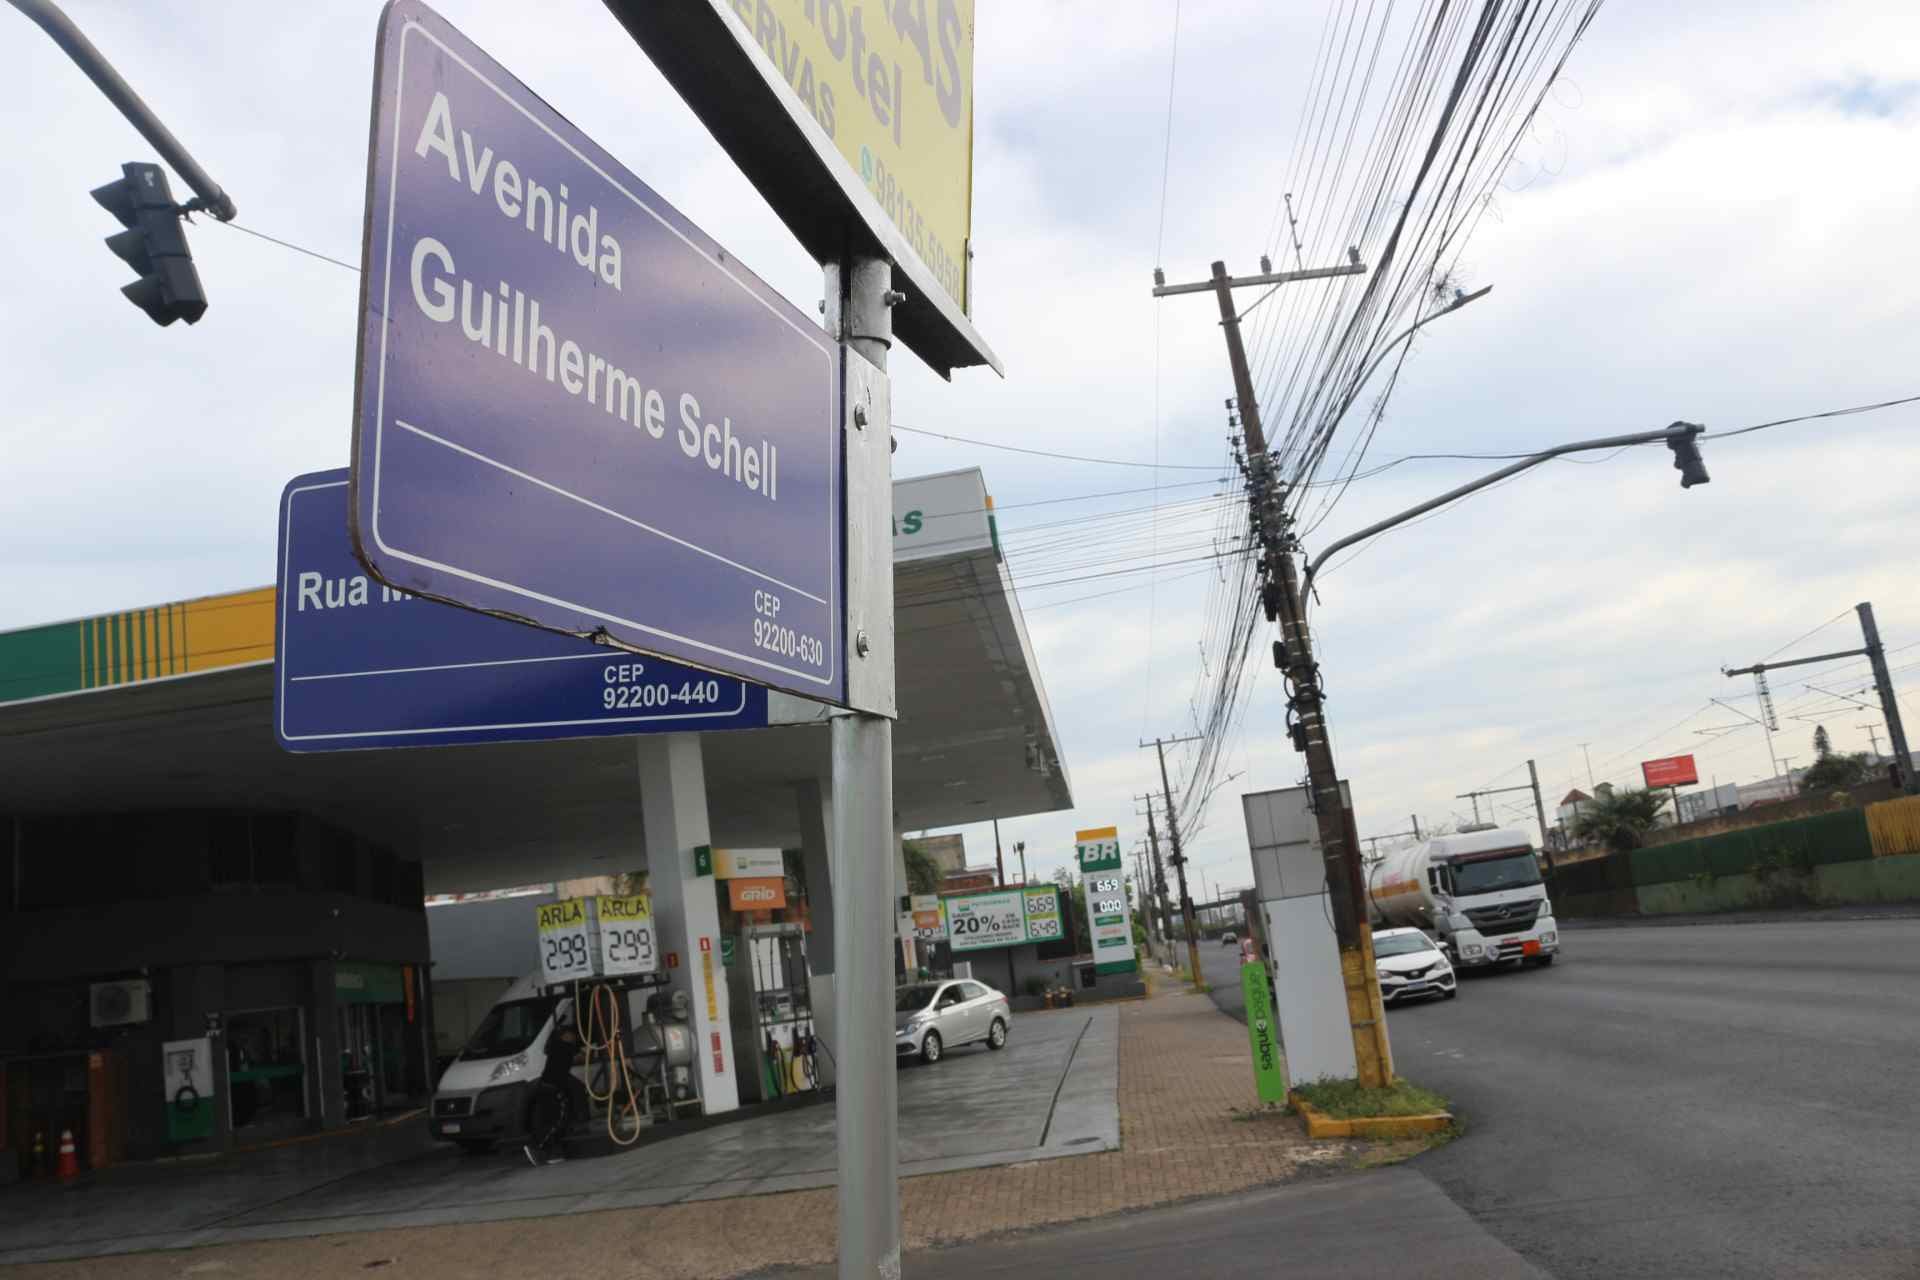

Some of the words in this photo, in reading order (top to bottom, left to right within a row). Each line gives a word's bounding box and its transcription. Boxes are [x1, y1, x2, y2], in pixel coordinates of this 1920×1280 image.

[414, 90, 623, 292] Avenida
[410, 236, 667, 440] Guilherme
[677, 392, 777, 502] Schell
[297, 571, 369, 612] Rua
[754, 589, 780, 618] CEP
[753, 618, 823, 667] 92200-630
[603, 663, 645, 684] CEP
[603, 680, 719, 710] 92200-440
[1083, 841, 1118, 864] BR
[540, 902, 583, 928] ARLA
[601, 899, 647, 917] ARLA
[953, 915, 1000, 936] 20%
